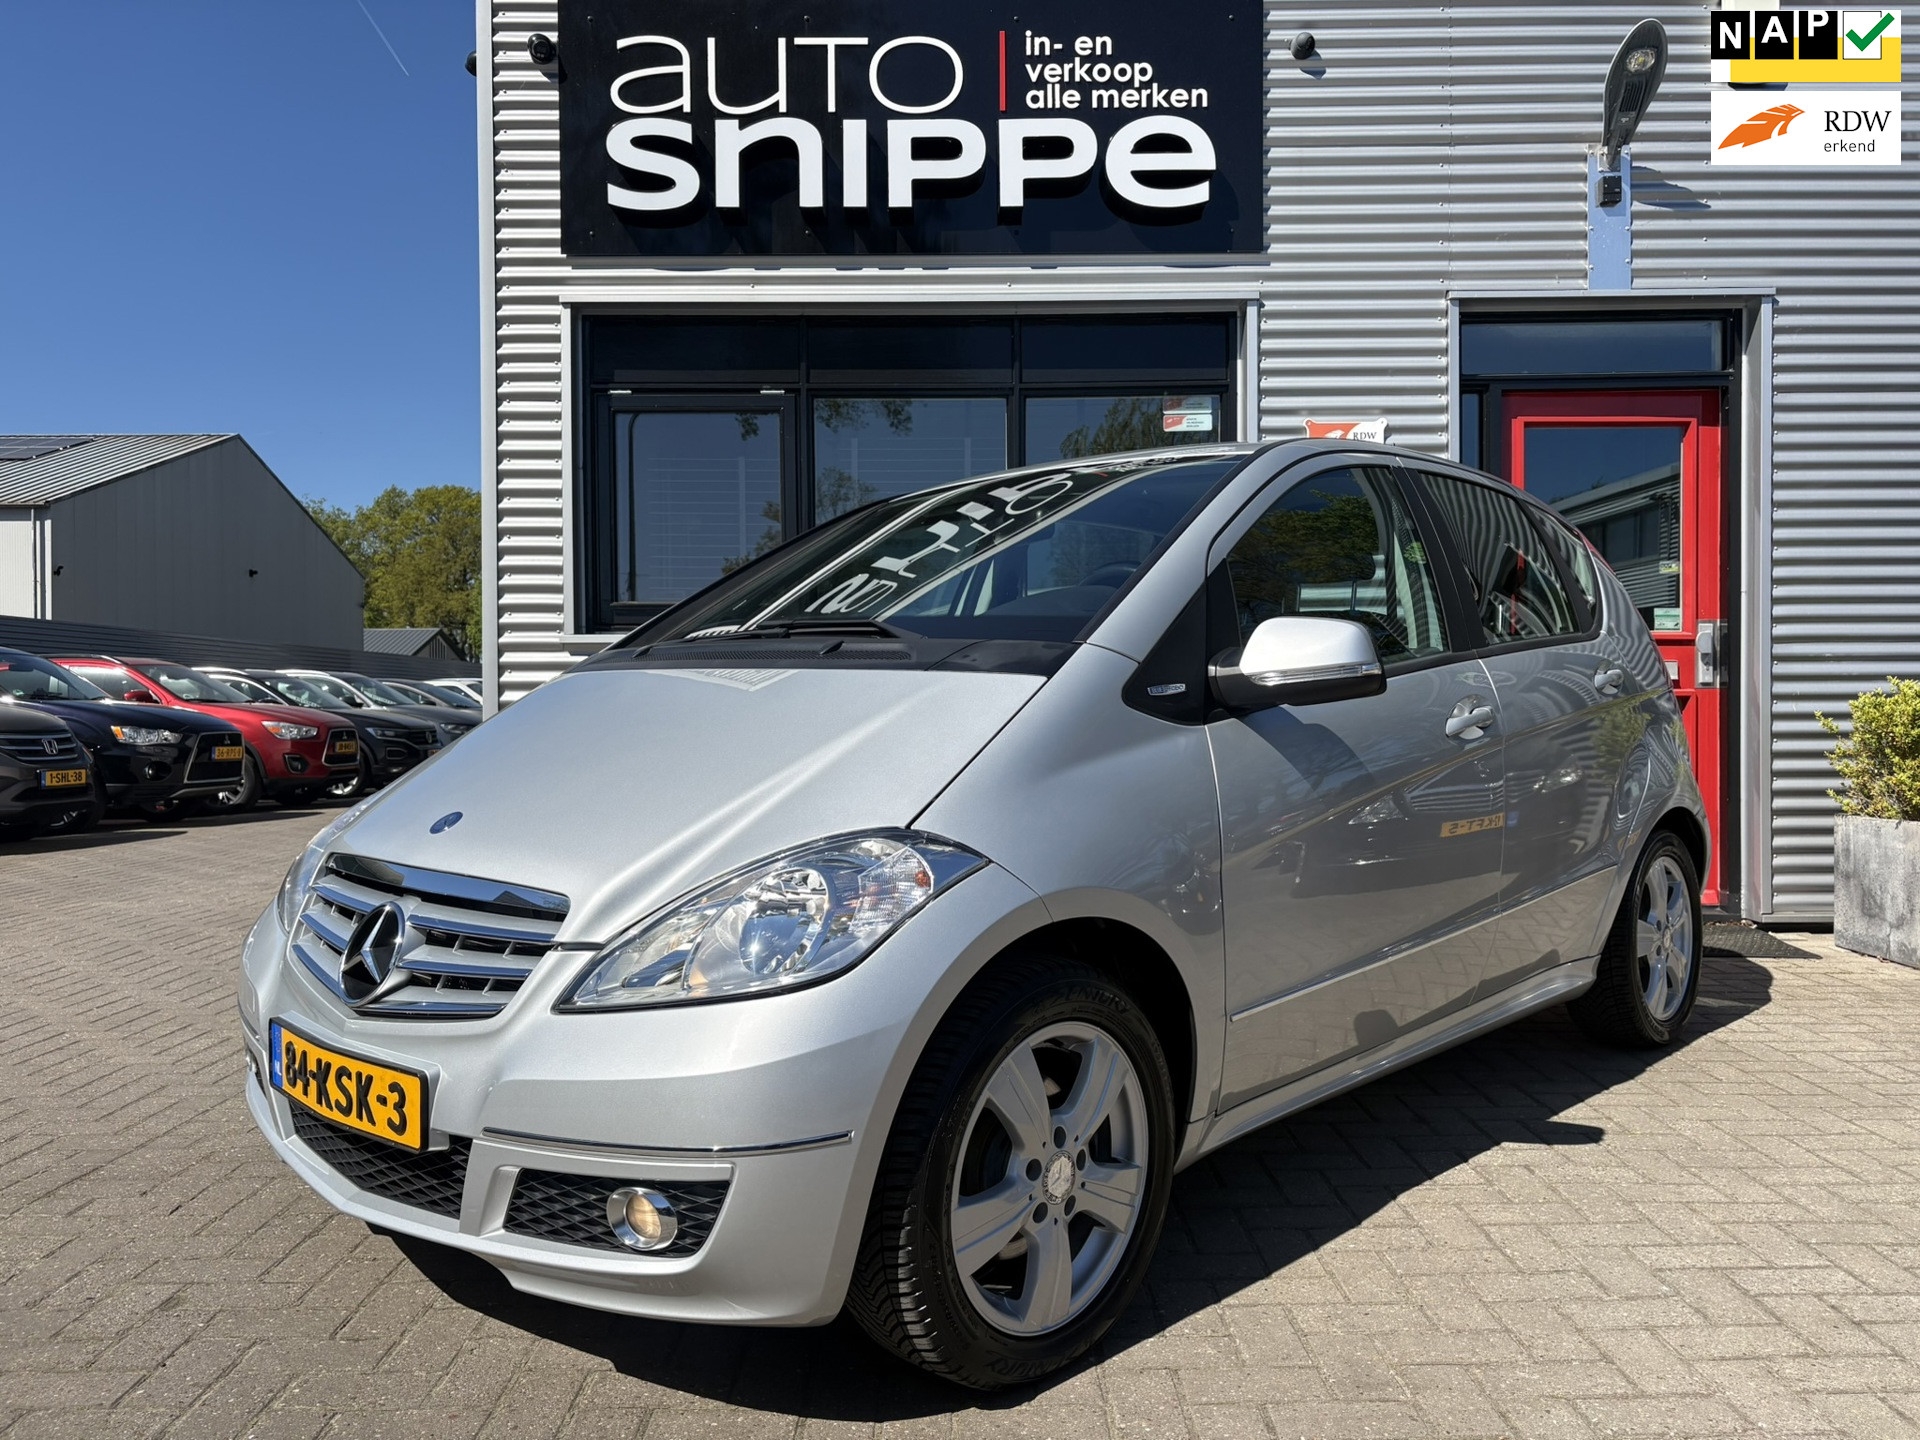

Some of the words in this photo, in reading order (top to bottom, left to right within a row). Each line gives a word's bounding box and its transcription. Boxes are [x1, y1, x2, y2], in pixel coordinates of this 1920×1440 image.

[1025, 30, 1063, 56] in-
[1074, 35, 1113, 56] en
[1025, 57, 1153, 88] verkoop
[1025, 83, 1082, 109] alle
[1091, 83, 1208, 109] merken
[1352, 431, 1377, 441] RDW
[50, 771, 83, 784] 1-SHL-38
[284, 1040, 408, 1137] 84-KSK-3
